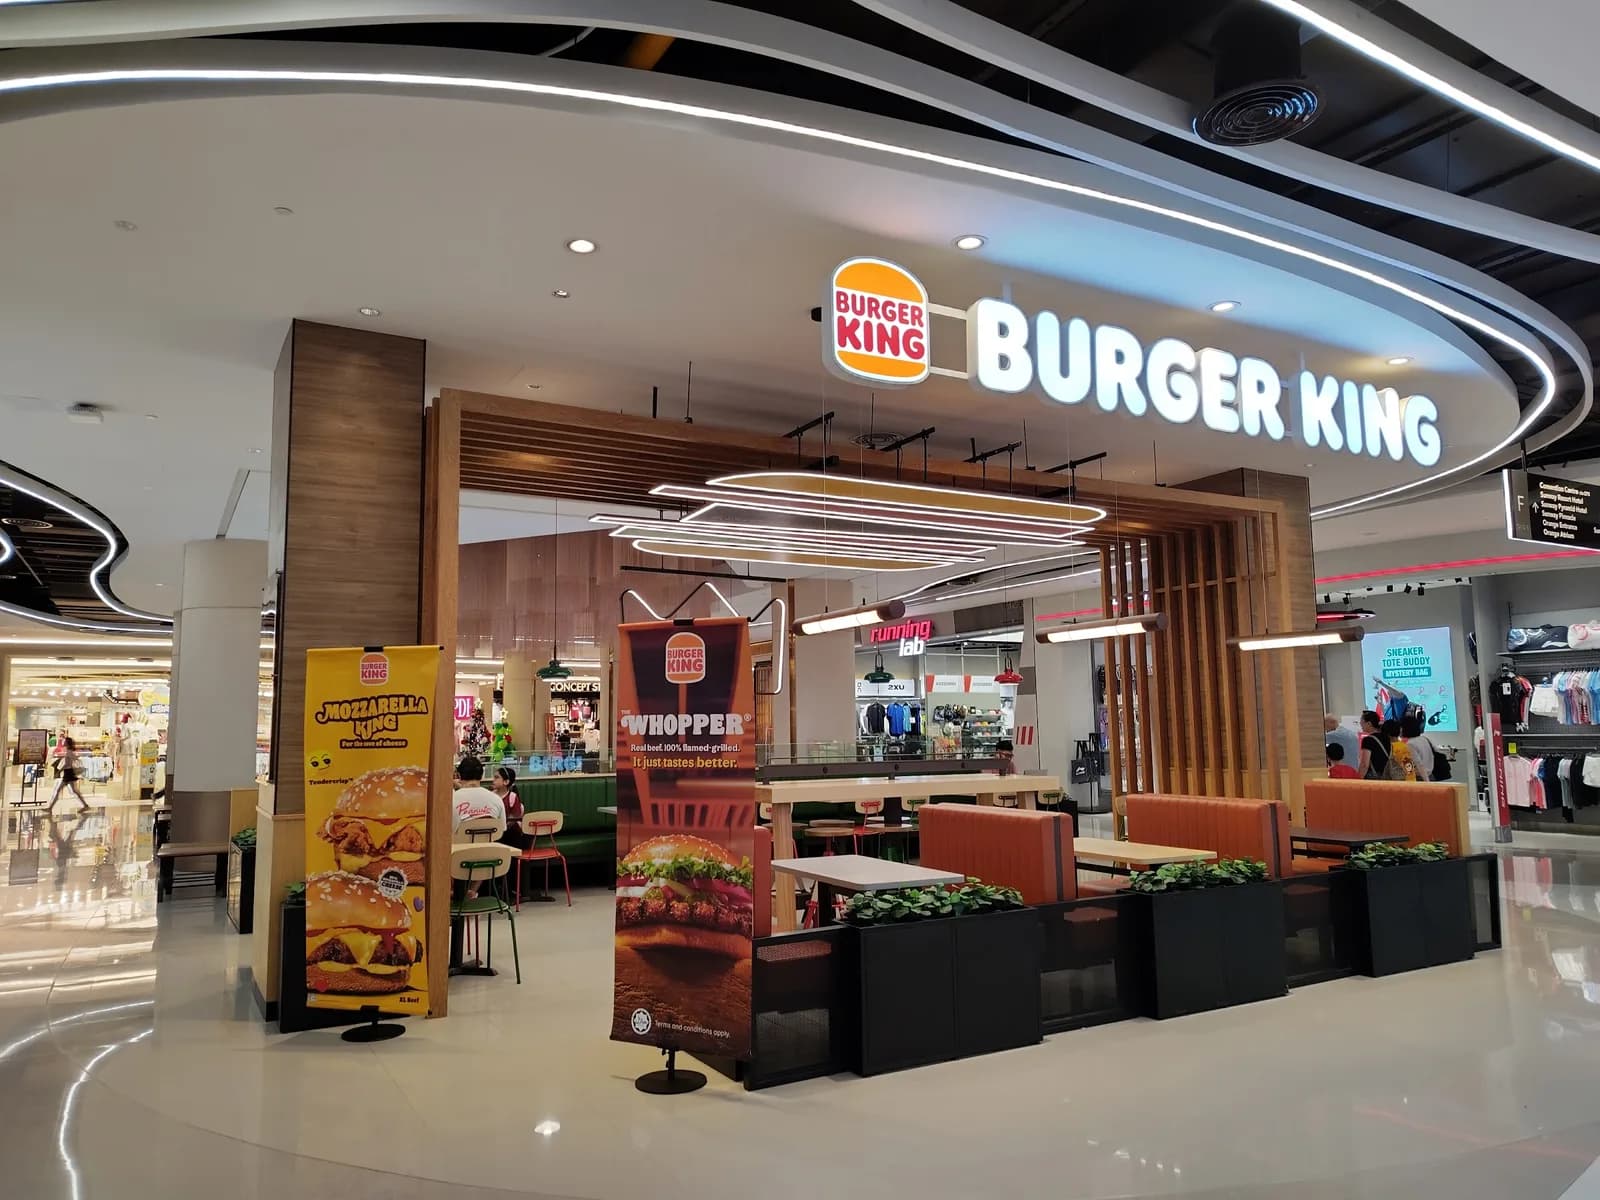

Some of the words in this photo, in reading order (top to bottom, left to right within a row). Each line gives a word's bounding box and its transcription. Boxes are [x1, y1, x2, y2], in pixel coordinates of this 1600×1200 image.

[836, 290, 924, 328] BURGER
[836, 316, 925, 360] KING
[974, 297, 1285, 441] BURGER
[1299, 370, 1441, 466] KING
[1517, 495, 1525, 511] F
[870, 619, 932, 642] running
[668, 649, 704, 659] BURGER
[899, 637, 926, 657] lab
[1386, 647, 1424, 657] SNEAKER
[668, 659, 704, 673] KING
[1382, 659, 1401, 667] TOTE
[1403, 656, 1431, 666] BUDDY
[361, 669, 387, 679] KING
[1385, 669, 1414, 677] MYSTERY
[316, 695, 428, 723] MOZZARELLA
[355, 714, 397, 739] KING
[631, 743, 646, 752] Real
[664, 743, 681, 752] 100%
[633, 756, 641, 767] It
[642, 756, 661, 769] just
[663, 757, 694, 768] tastes
[697, 756, 737, 768] better.
[655, 1020, 671, 1029] Terms
[683, 1025, 712, 1035] conditions
